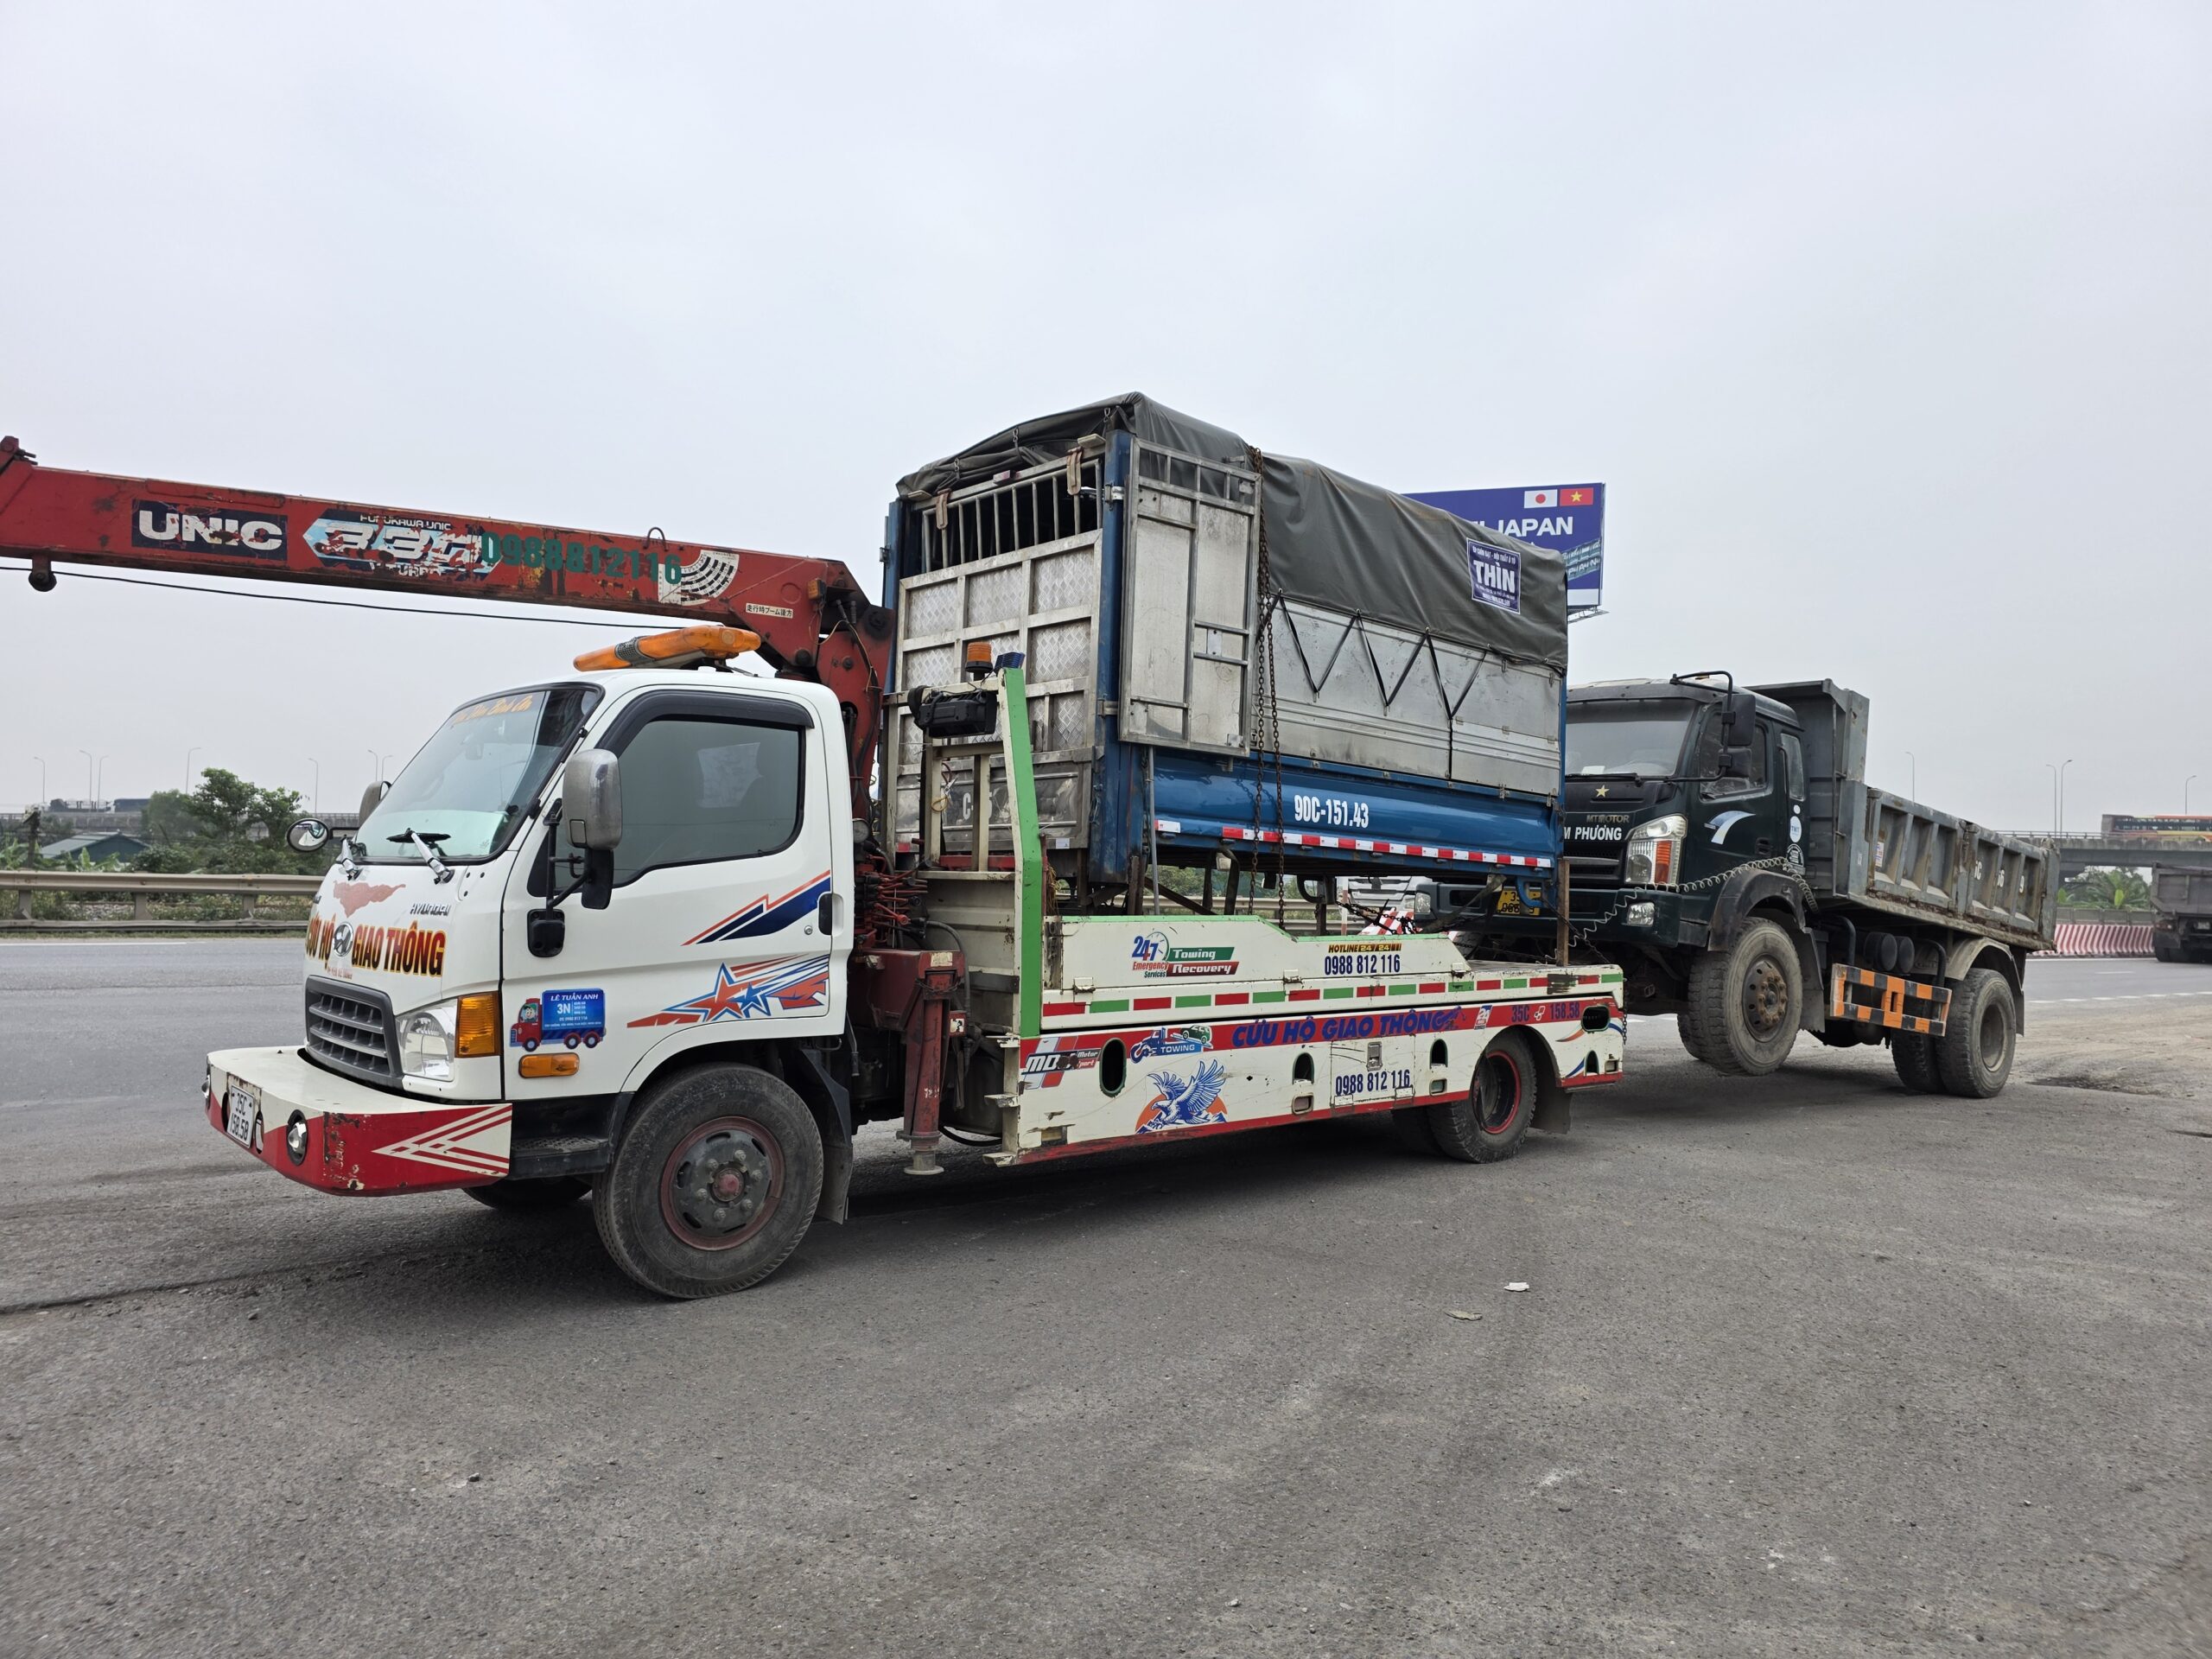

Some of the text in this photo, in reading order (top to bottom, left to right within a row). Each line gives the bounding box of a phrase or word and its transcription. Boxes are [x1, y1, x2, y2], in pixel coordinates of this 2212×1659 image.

[138, 510, 283, 551] UNIC
[426, 520, 451, 531] UNIC
[480, 531, 683, 585] 0988812116
[1473, 560, 1516, 594] THÌN
[1294, 794, 1370, 829] 90C-151.43
[1574, 825, 1622, 841] PHƯƠNG
[410, 903, 452, 916] HYUNDAI
[319, 912, 336, 969] HỘ
[351, 924, 385, 970] GIAO
[383, 919, 447, 977] THÔNG
[1328, 944, 1358, 953] HOTLINE
[1173, 949, 1217, 960] Towing
[1133, 962, 1169, 971] Emergency
[1144, 969, 1166, 978] Services
[1173, 963, 1232, 975] Recovery
[1325, 954, 1400, 976] 0988 812 116
[556, 1003, 571, 1014] 3N
[1511, 1002, 1580, 1022] 35C 158.58
[1232, 1008, 1446, 1048] CỨU HỘ GIAO THÔNG
[1077, 1050, 1098, 1058] Motor
[1160, 1044, 1196, 1053] TOWING
[1336, 1069, 1410, 1096] 0988 812 116
[236, 1092, 248, 1116] 35C
[230, 1112, 250, 1141] 158.58
